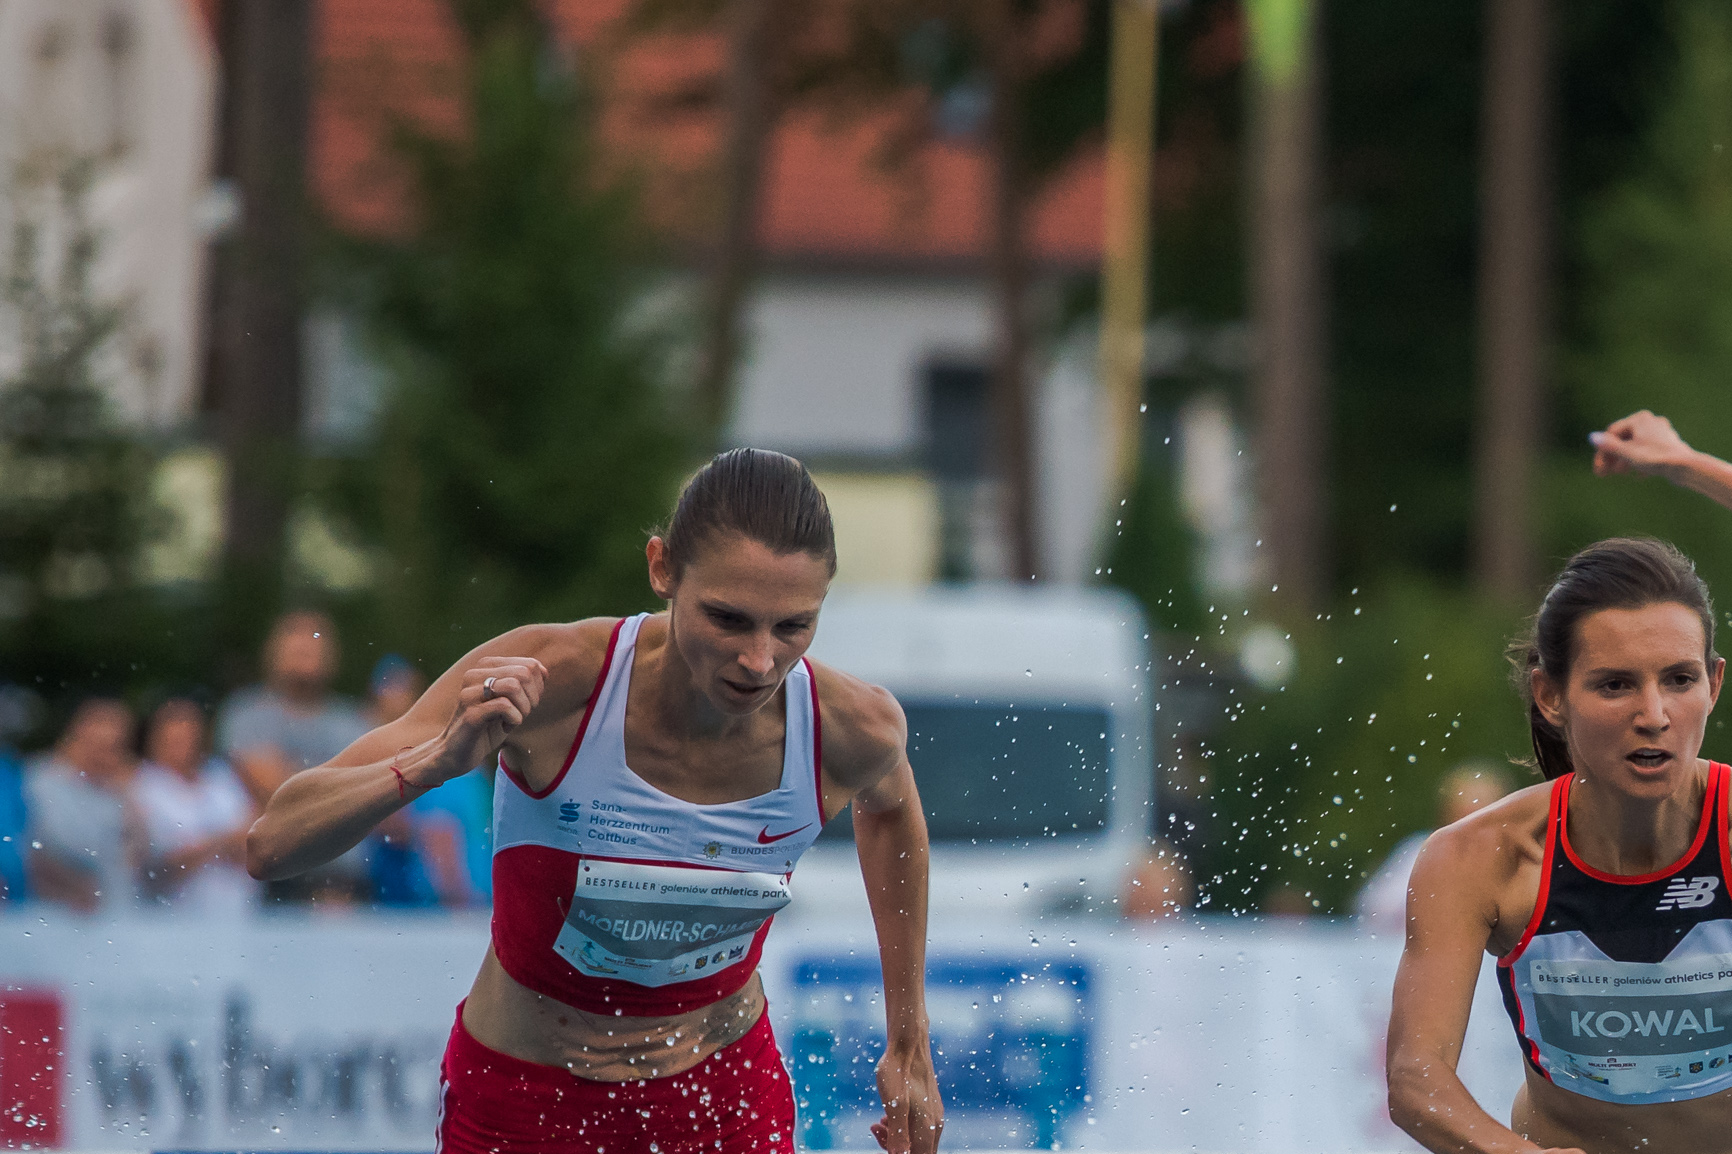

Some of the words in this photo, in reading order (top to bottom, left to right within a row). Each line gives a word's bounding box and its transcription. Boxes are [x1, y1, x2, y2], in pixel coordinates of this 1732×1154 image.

[591, 800, 627, 812] Sana-
[590, 815, 670, 834] Herzzentrum
[588, 829, 637, 845] Cottbus
[585, 877, 656, 891] BESTSELLER
[660, 883, 708, 895] goleniów
[711, 886, 759, 897] athletics
[762, 888, 788, 899] park
[1538, 974, 1609, 985] BESTSELLER
[1613, 976, 1662, 988] goleniów
[1664, 971, 1714, 984] athletics
[1570, 1007, 1725, 1038] KOWAL
